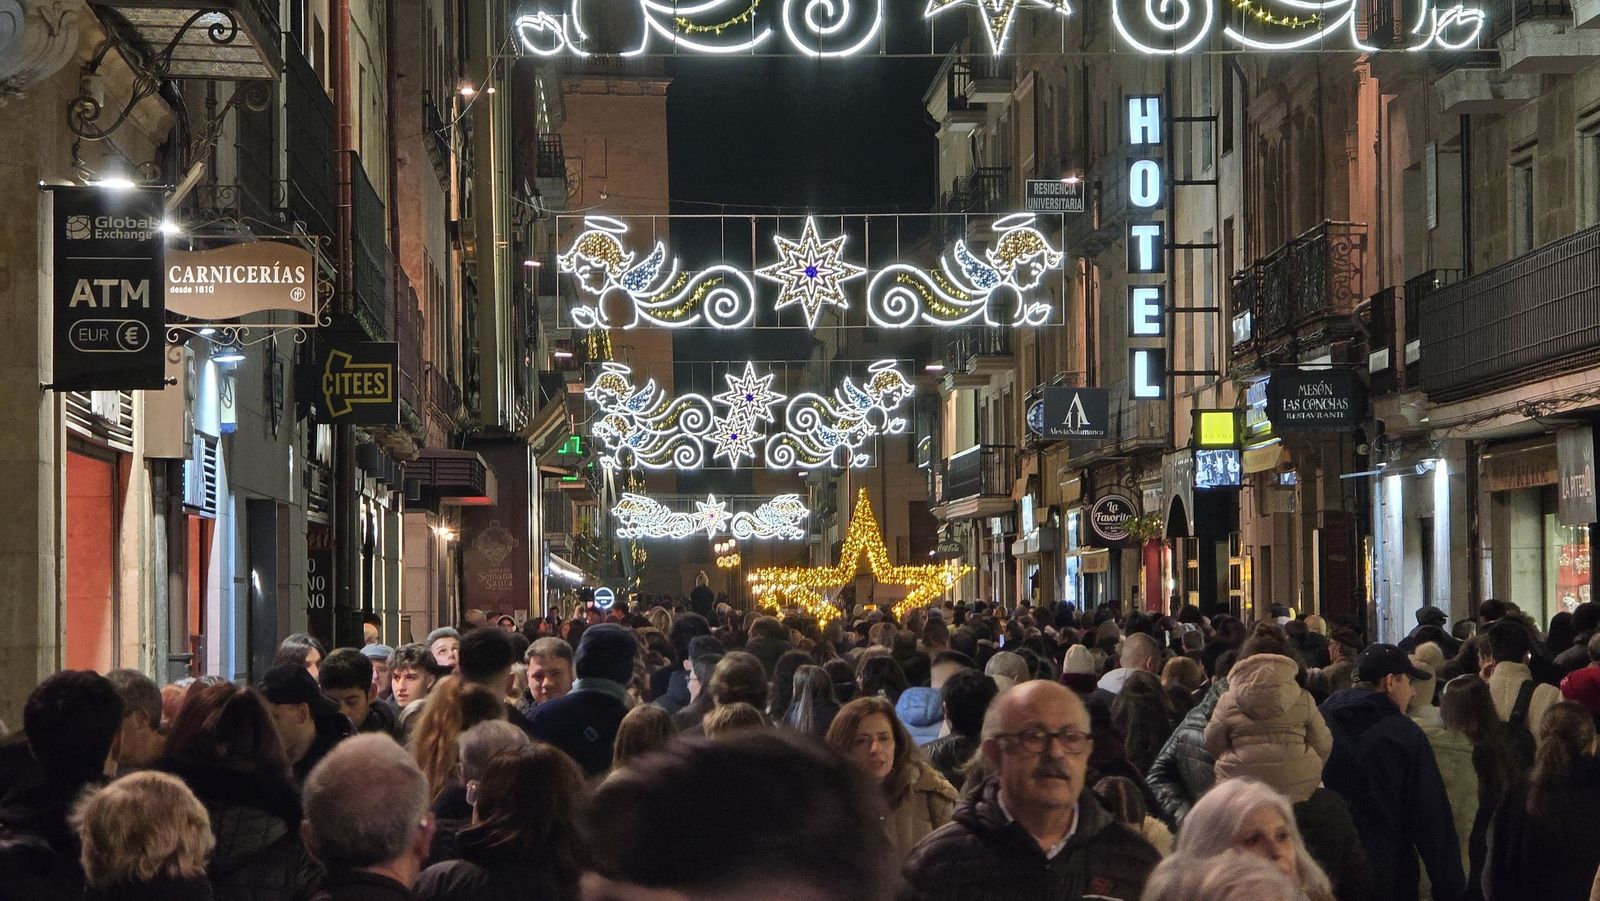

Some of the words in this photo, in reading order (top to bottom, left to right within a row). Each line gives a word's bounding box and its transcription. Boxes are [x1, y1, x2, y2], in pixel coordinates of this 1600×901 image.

[1033, 182, 1077, 195] RESIDENCIA
[1027, 197, 1082, 210] UNIVERSITARIA
[94, 215, 157, 229] Global
[94, 229, 153, 241] Exchange
[1128, 97, 1161, 398] HOTEL
[168, 260, 306, 284] CARNICERÍAS
[69, 278, 150, 308] ATM
[169, 285, 193, 294] desde
[194, 285, 215, 294] 1810
[79, 328, 109, 341] EUR
[322, 372, 385, 395] CITEES
[1297, 380, 1333, 396] MESÓN
[1282, 399, 1301, 412] LAS
[1302, 397, 1349, 411] CONCHAS
[1562, 477, 1571, 499] LA
[1106, 501, 1119, 514] La
